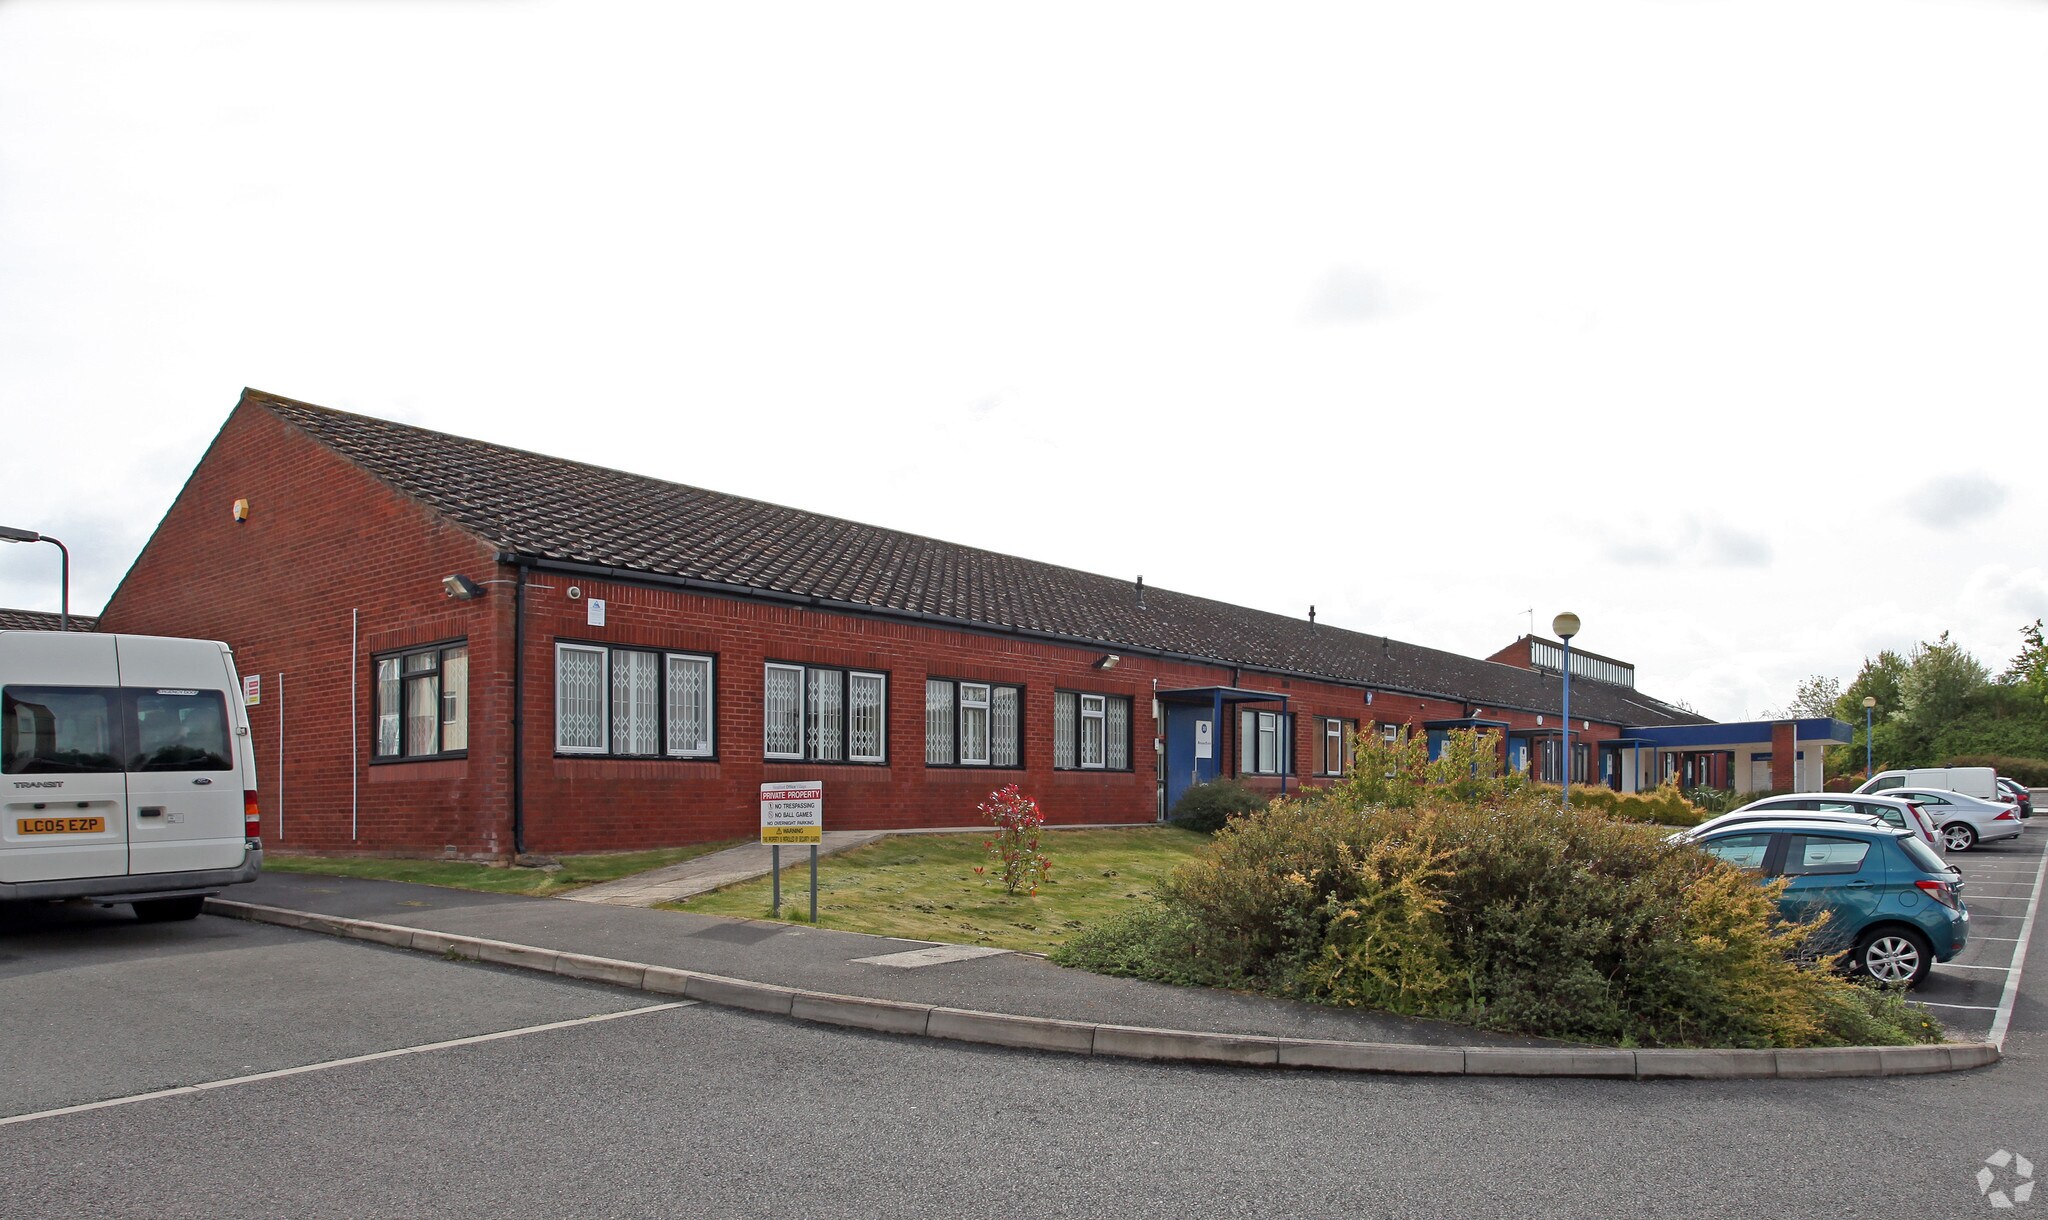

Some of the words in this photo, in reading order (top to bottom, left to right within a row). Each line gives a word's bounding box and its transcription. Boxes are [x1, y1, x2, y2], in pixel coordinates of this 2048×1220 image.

[762, 792, 786, 800] PRIVATE
[788, 791, 820, 799] PROPERTY
[23, 820, 65, 832] LC05
[69, 819, 98, 831] EZP
